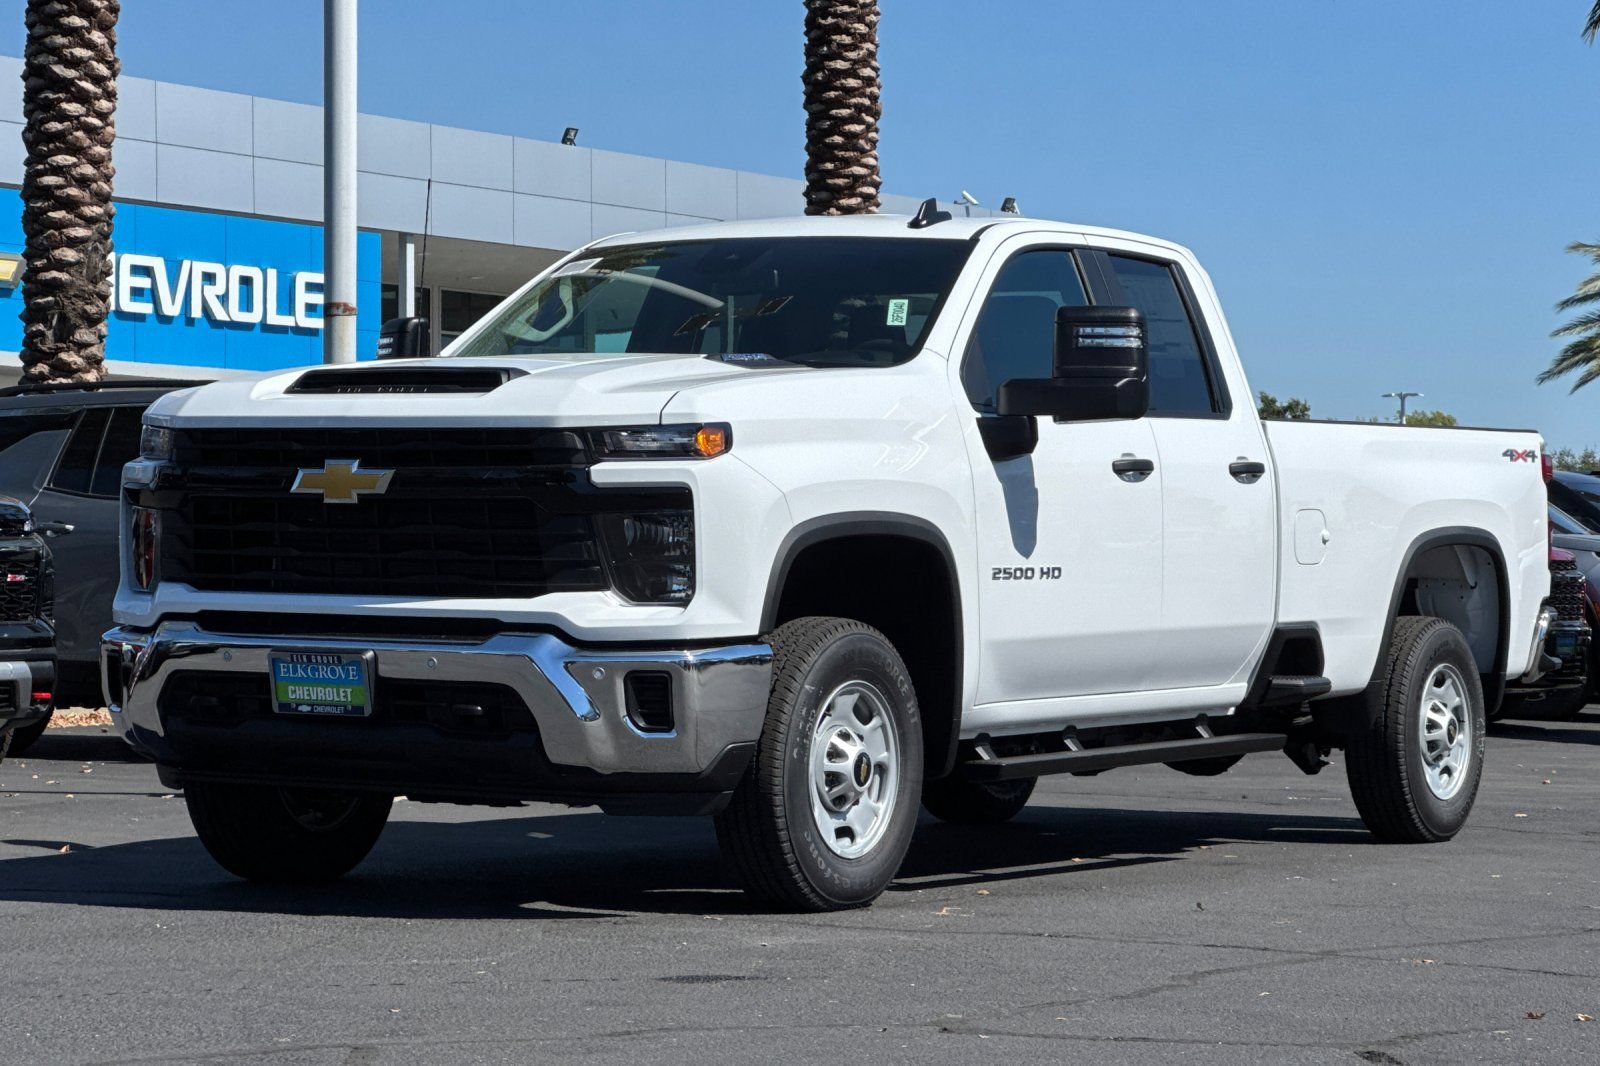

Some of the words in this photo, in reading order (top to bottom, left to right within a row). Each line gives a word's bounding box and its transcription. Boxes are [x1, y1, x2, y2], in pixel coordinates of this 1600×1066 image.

[105, 251, 324, 329] EVROLE
[991, 567, 1035, 581] 2500
[1039, 566, 1062, 580] HD
[288, 685, 353, 702] CHEVROLET
[313, 705, 345, 714] CHEVROLET
